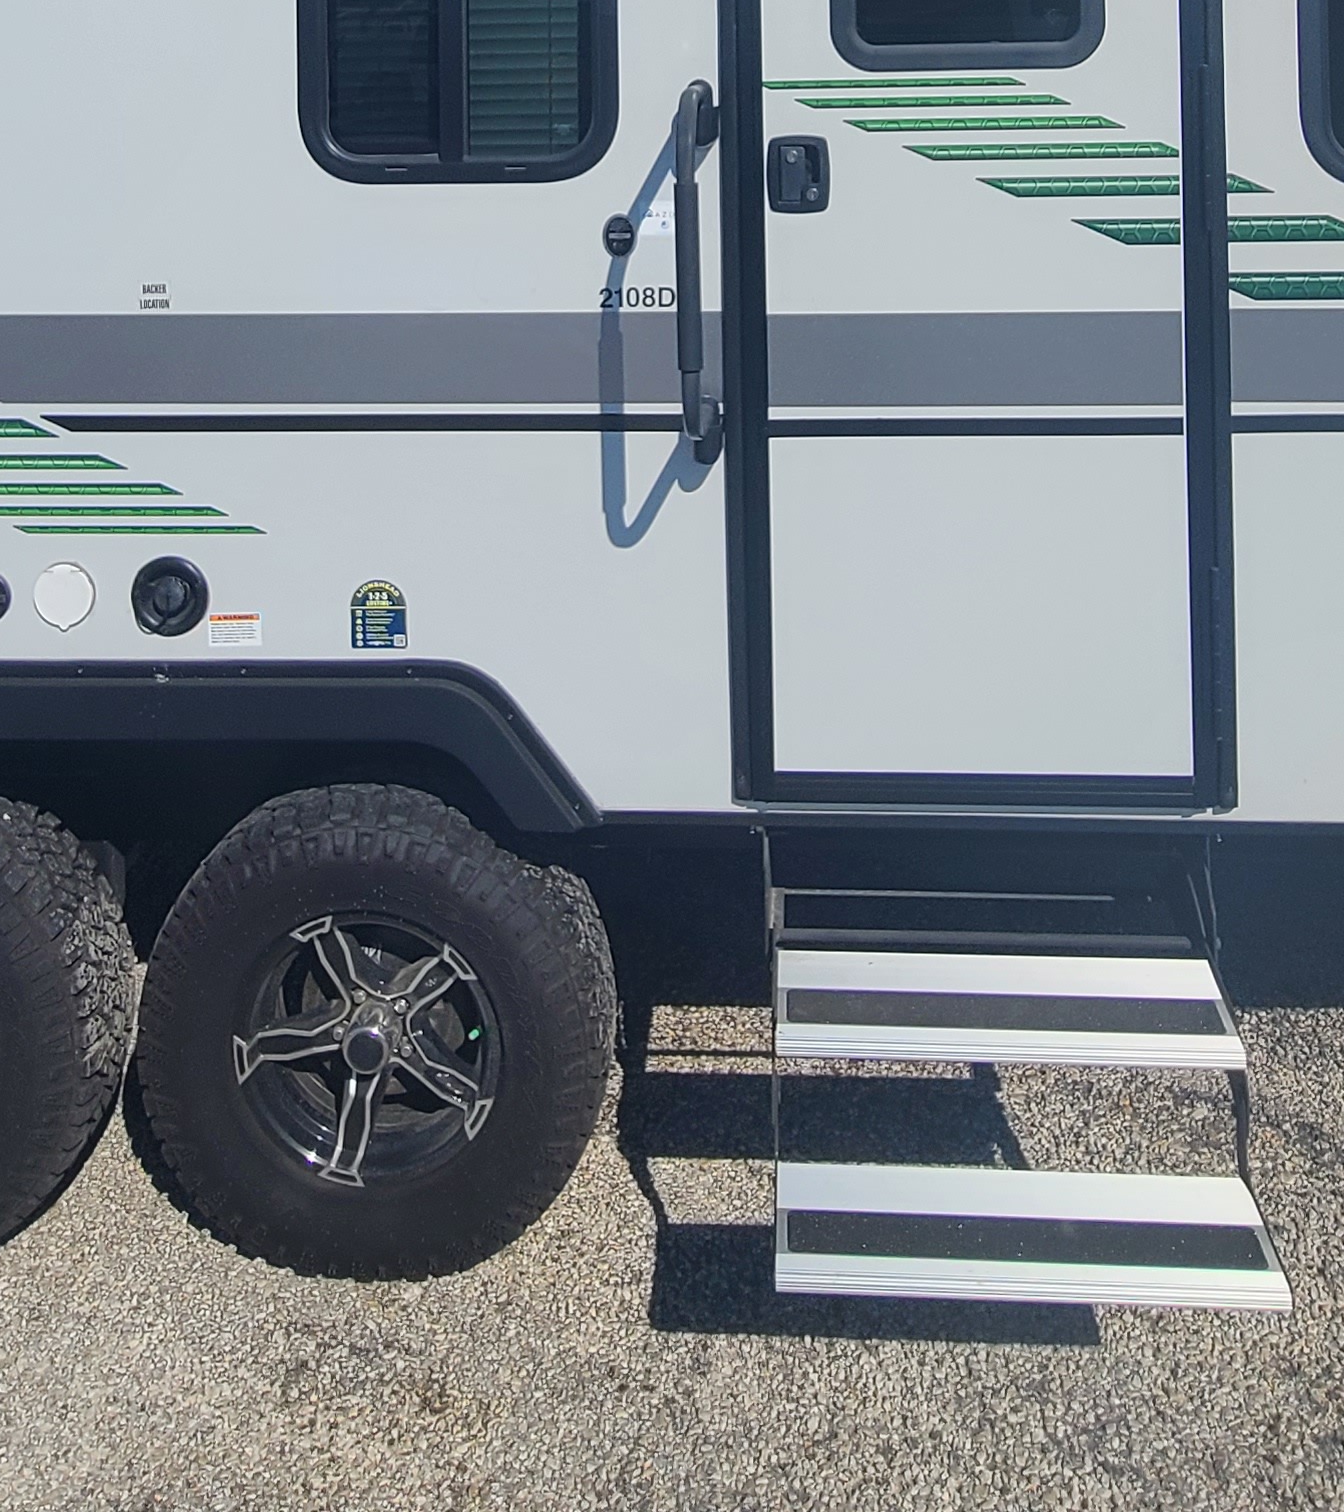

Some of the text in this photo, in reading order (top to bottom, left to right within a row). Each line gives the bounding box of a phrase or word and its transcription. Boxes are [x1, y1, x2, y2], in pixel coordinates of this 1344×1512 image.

[142, 283, 167, 294] BACKER
[599, 286, 676, 309] 2108D
[139, 298, 170, 310] LOCATION
